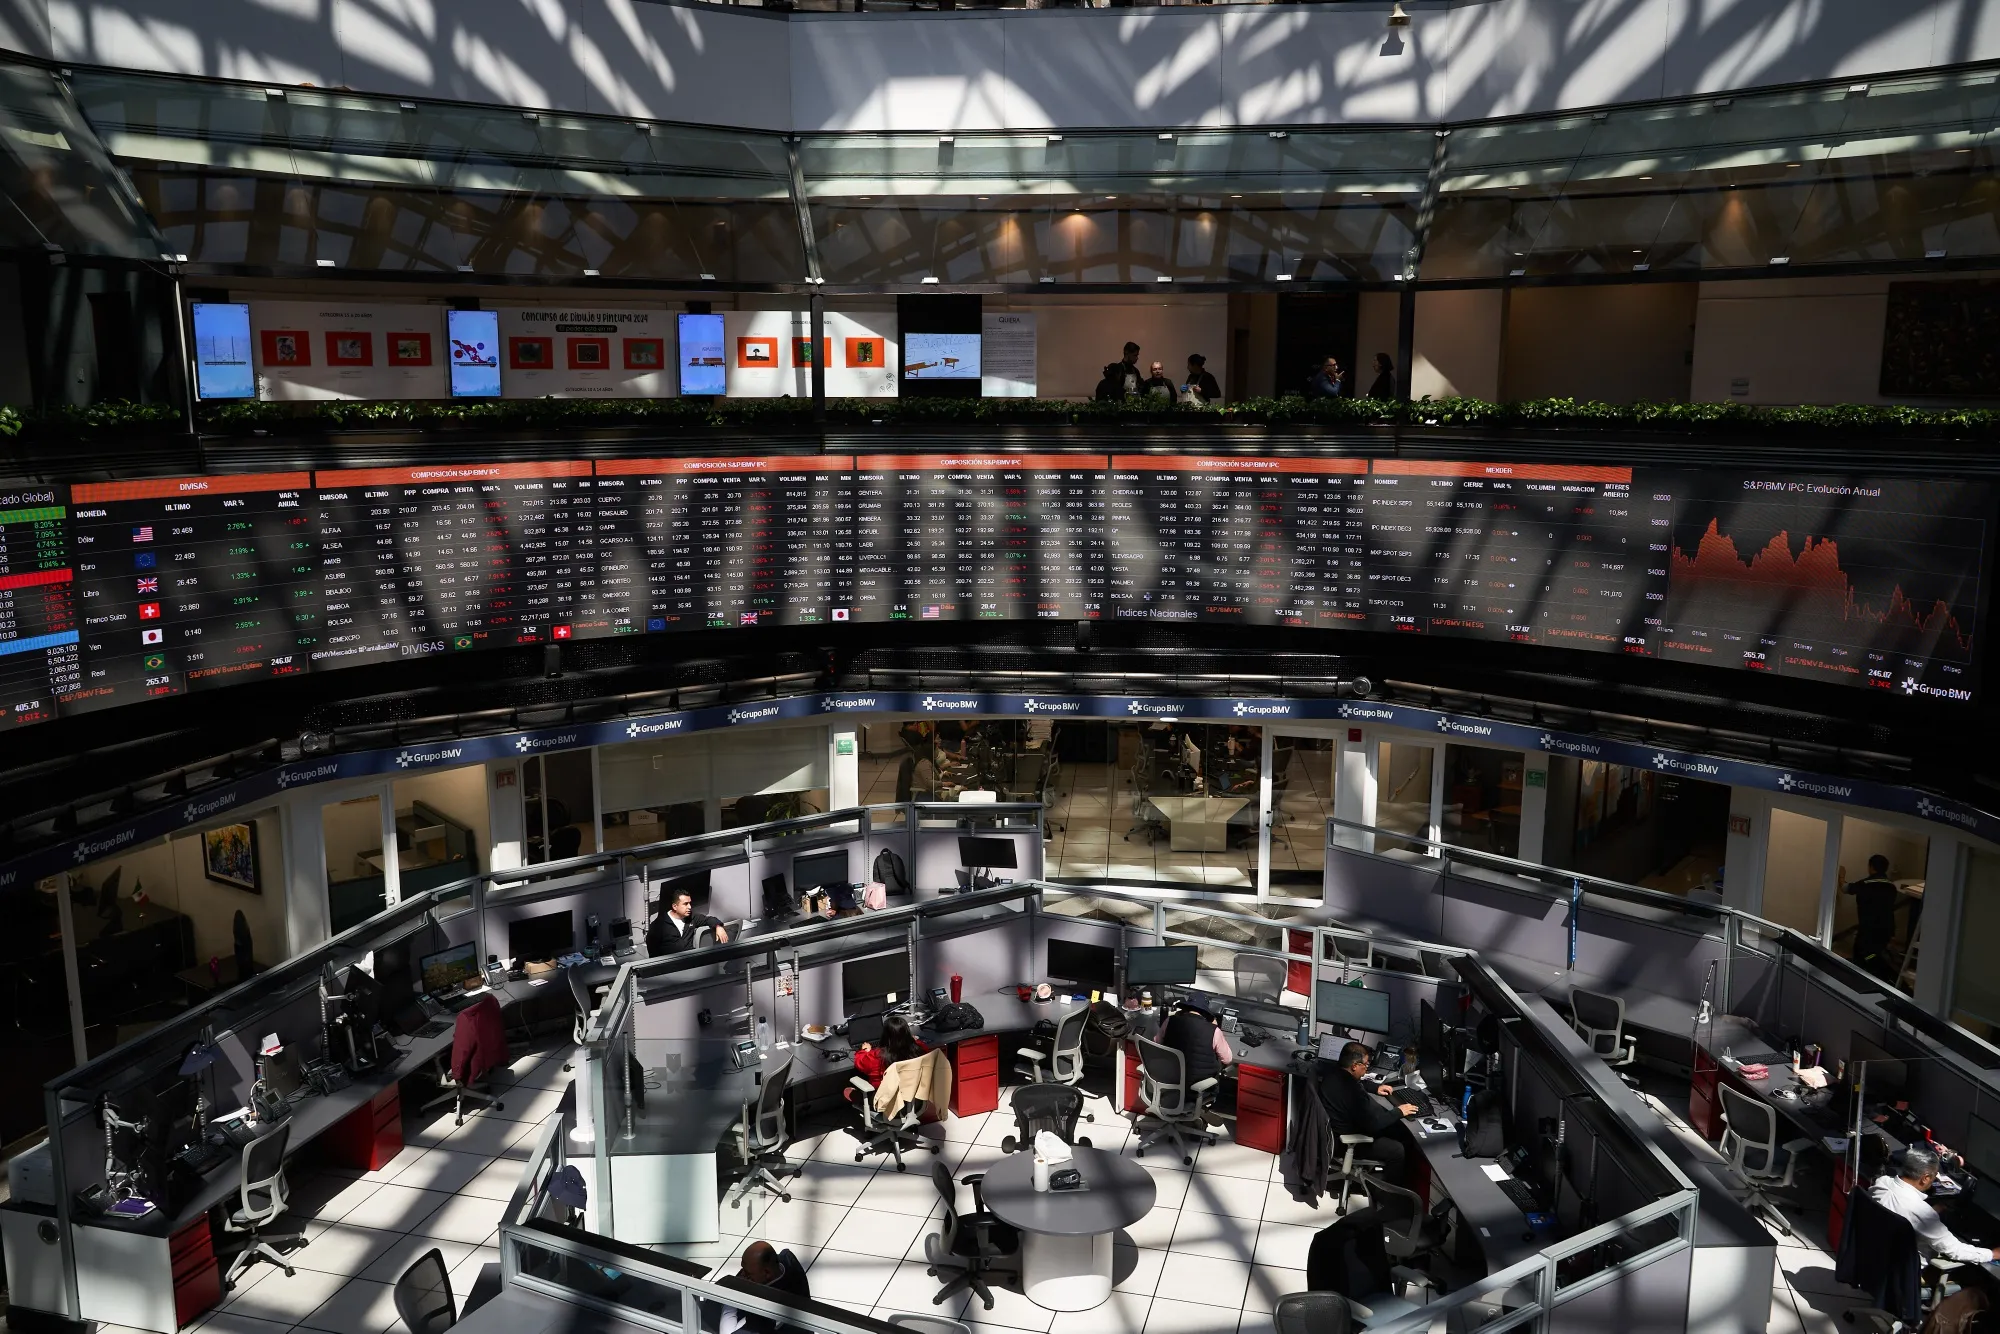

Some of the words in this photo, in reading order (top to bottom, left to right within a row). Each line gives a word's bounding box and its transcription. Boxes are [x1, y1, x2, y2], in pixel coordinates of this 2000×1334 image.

[559, 312, 568, 321] de
[684, 461, 726, 469] COMPOSICIÓN
[412, 470, 457, 478] COMPOSICIÓN
[180, 482, 208, 491] DIVISAS
[1743, 480, 1786, 491] S&P/BMV
[1788, 483, 1804, 492] IPC
[1807, 484, 1851, 495] Evolución
[1852, 487, 1880, 497] Anual
[22, 491, 55, 502] Global)
[1653, 494, 1671, 502] 60000
[76, 510, 107, 518] MONEDA
[165, 503, 190, 511] ULTIMO
[1649, 544, 1668, 552] 56000
[81, 563, 96, 571] Euro
[1648, 568, 1666, 577] 54000
[84, 590, 99, 598] Libra
[1646, 593, 1664, 601] 52000
[1117, 606, 1147, 617] Índices
[1150, 608, 1198, 619] Nacionales
[185, 628, 202, 636] 0.140
[401, 641, 445, 655] DIVISAS
[1743, 651, 1765, 660] 265.70
[146, 676, 169, 687] 265.70
[1919, 684, 1947, 698] Grupo
[1948, 688, 1972, 701] BMV
[835, 699, 857, 709] Grupo
[858, 699, 876, 707] BMV
[936, 700, 960, 710] Grupo
[960, 700, 978, 709] BMV
[1039, 702, 1062, 712] Grupo
[1062, 702, 1080, 711] BMV
[1143, 703, 1166, 713] Grupo
[1167, 704, 1185, 713] BMV
[741, 709, 762, 720] Grupo
[763, 707, 779, 716] BMV
[1248, 705, 1271, 716] Grupo
[1272, 706, 1290, 714] BMV
[1352, 708, 1376, 719] Grupo
[1376, 710, 1394, 720] BMV
[641, 722, 664, 733] Grupo
[665, 720, 683, 730] BMV
[1451, 721, 1474, 733] Grupo
[1474, 726, 1492, 736] BMV
[532, 737, 557, 749] Grupo
[557, 734, 577, 746] BMV
[1556, 738, 1581, 752] Grupo
[1581, 743, 1601, 755] BMV
[413, 752, 441, 765] Grupo
[441, 748, 462, 760] BMV
[1669, 759, 1696, 774] Grupo
[1697, 763, 1719, 776] BMV
[290, 770, 317, 783] Grupo
[318, 764, 338, 778] BMV
[1797, 780, 1827, 795] Grupo
[1828, 784, 1852, 797] BMV
[198, 799, 220, 815] Grupo
[219, 792, 237, 808] BMV
[1935, 805, 1960, 822] Grupo
[1959, 812, 1978, 829] BMV
[90, 838, 116, 855] Grupo
[115, 829, 136, 847] BMV
